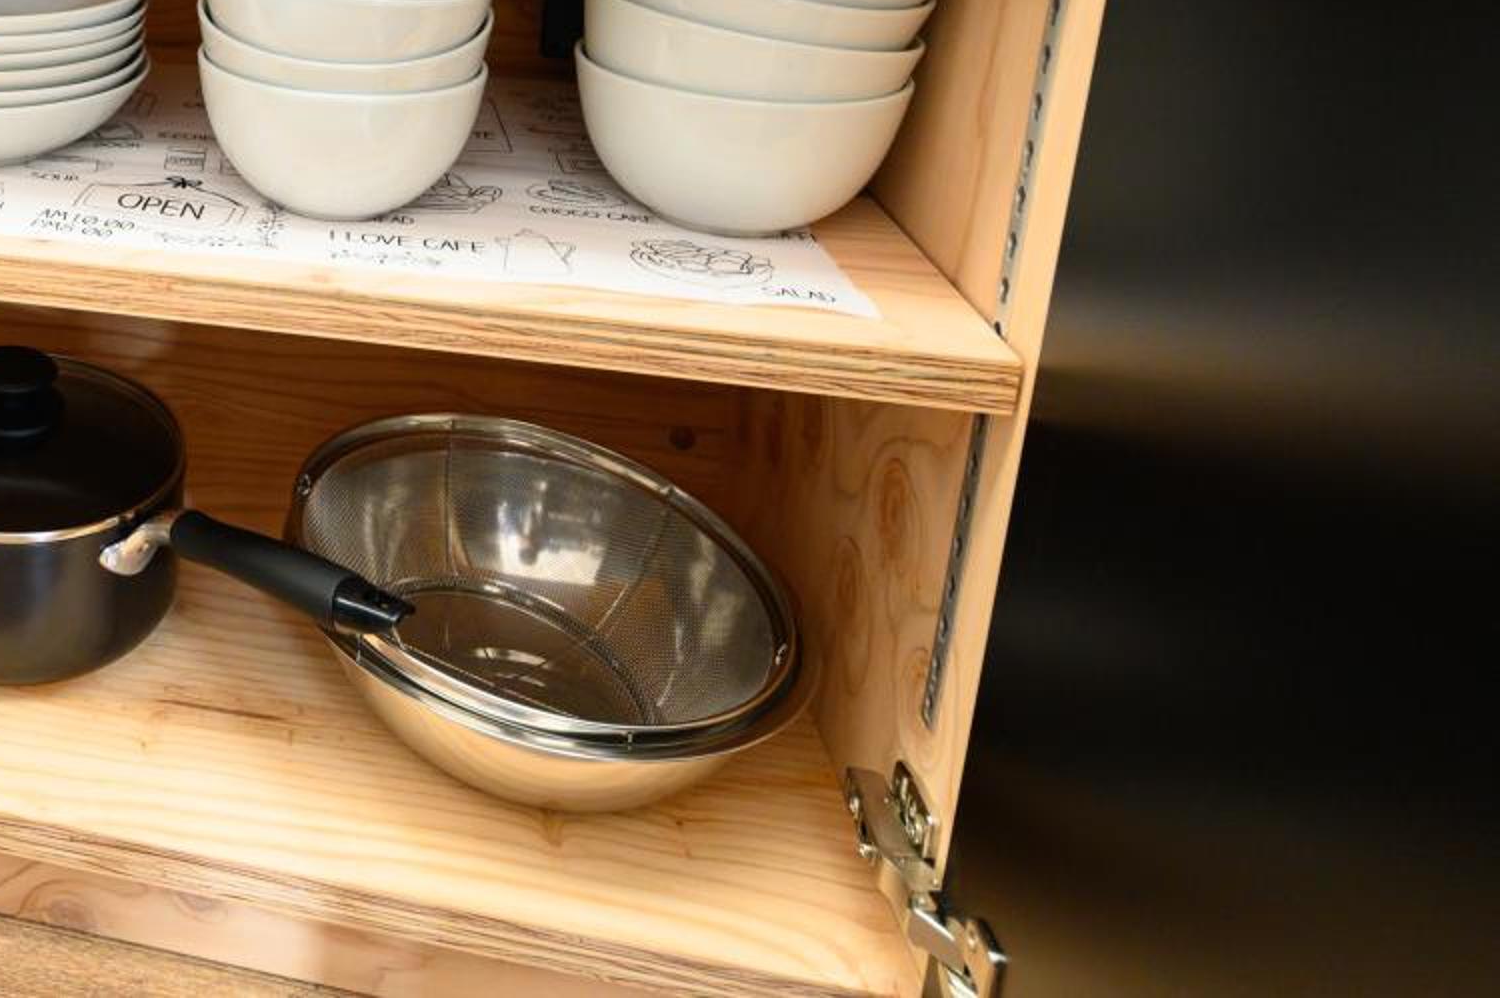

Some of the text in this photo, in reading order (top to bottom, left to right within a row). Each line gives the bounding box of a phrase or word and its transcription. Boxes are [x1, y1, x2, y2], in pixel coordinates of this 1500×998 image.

[117, 192, 206, 220] OPEN
[345, 231, 408, 246] LOVE
[423, 238, 485, 253] CAFE
